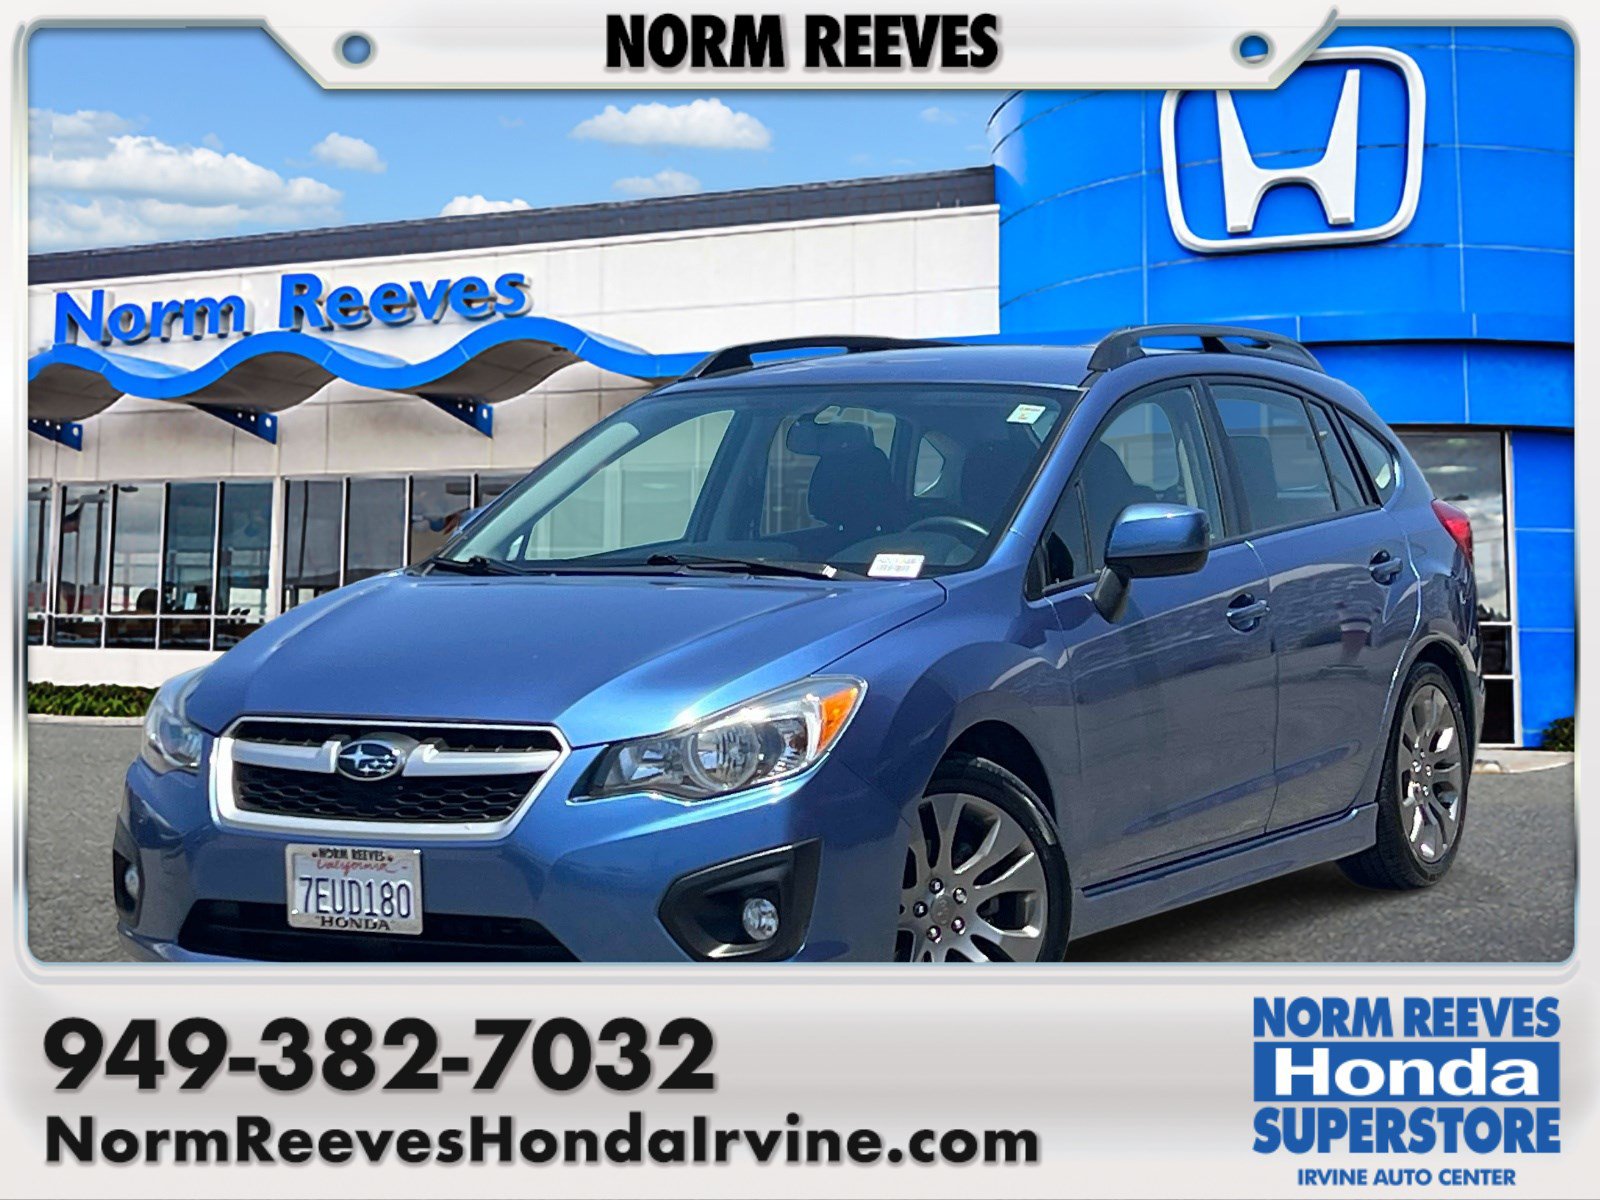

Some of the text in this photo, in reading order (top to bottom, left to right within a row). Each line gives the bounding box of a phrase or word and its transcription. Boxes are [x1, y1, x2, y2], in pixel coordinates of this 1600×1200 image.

[55, 271, 528, 345] Norm Reeves
[318, 847, 386, 862] NORM REEVES
[316, 859, 396, 876] California
[299, 876, 411, 919] 7EUD180
[320, 916, 391, 931] HONDA
